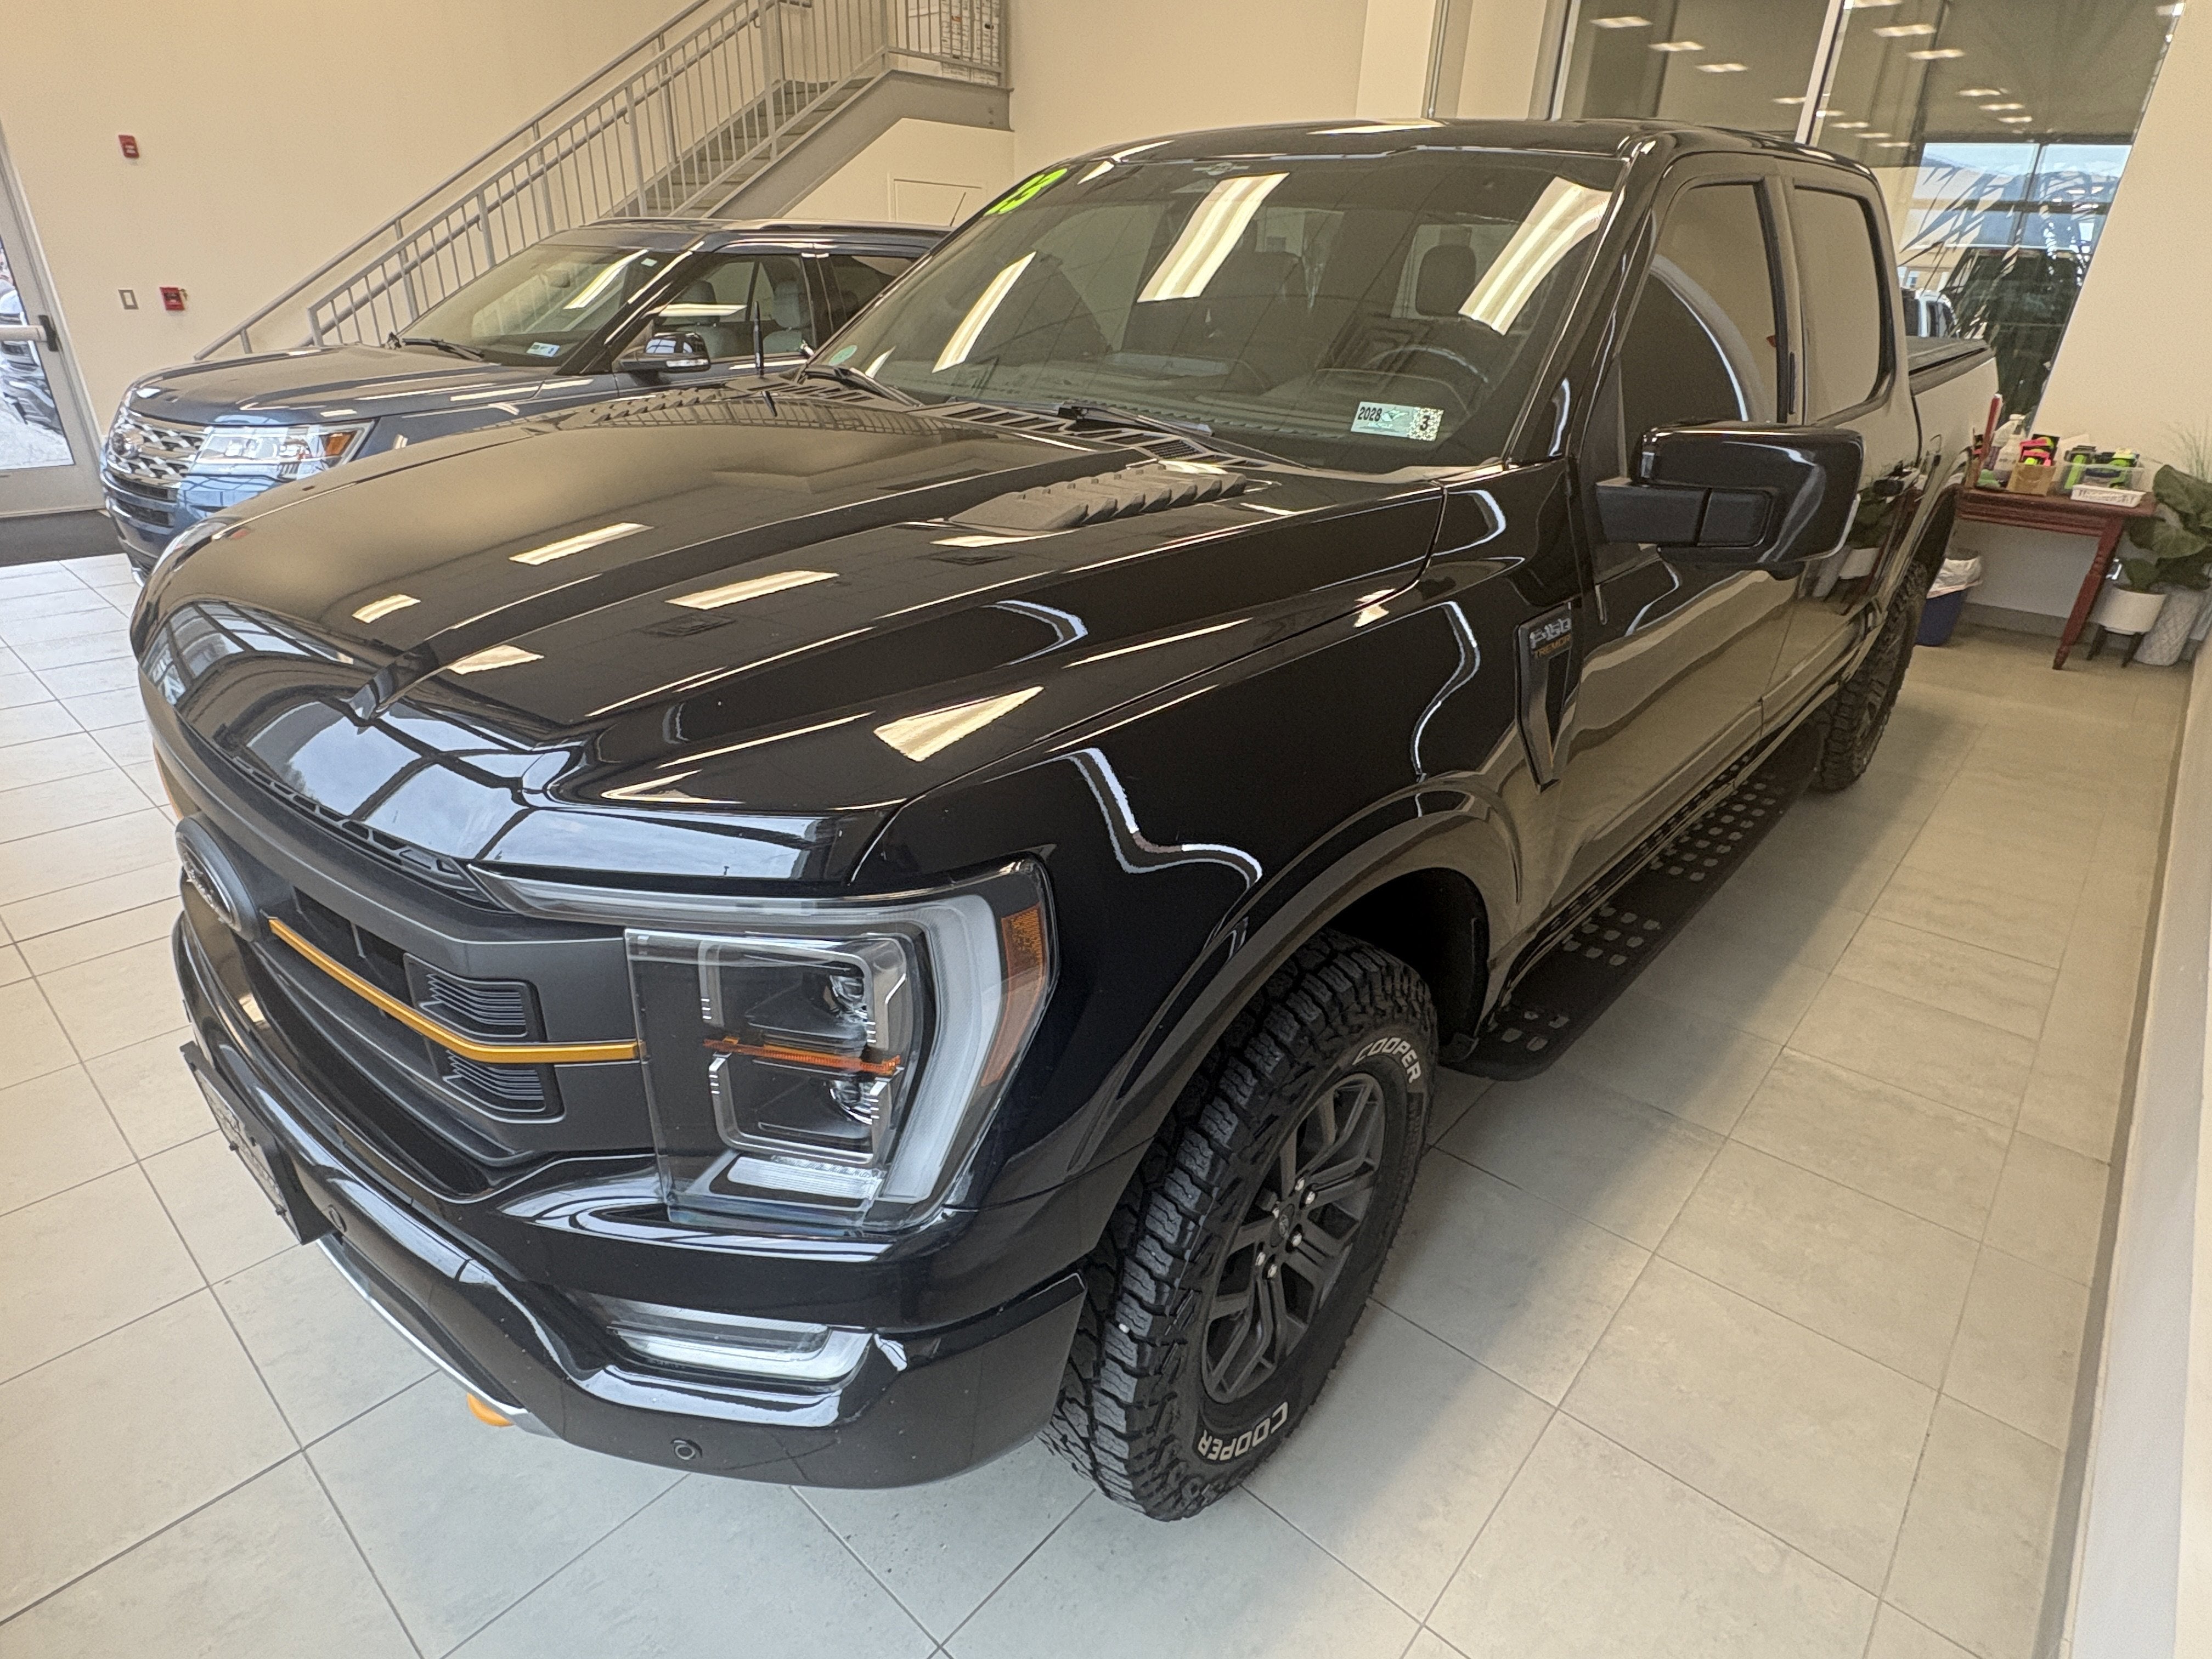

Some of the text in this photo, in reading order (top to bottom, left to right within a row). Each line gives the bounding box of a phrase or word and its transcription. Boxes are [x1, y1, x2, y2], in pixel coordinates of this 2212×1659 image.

[1357, 407, 1383, 421] 2028
[1420, 414, 1431, 431] 3
[1351, 1037, 1421, 1084] COOPER
[1198, 1401, 1288, 1462] COOPER
